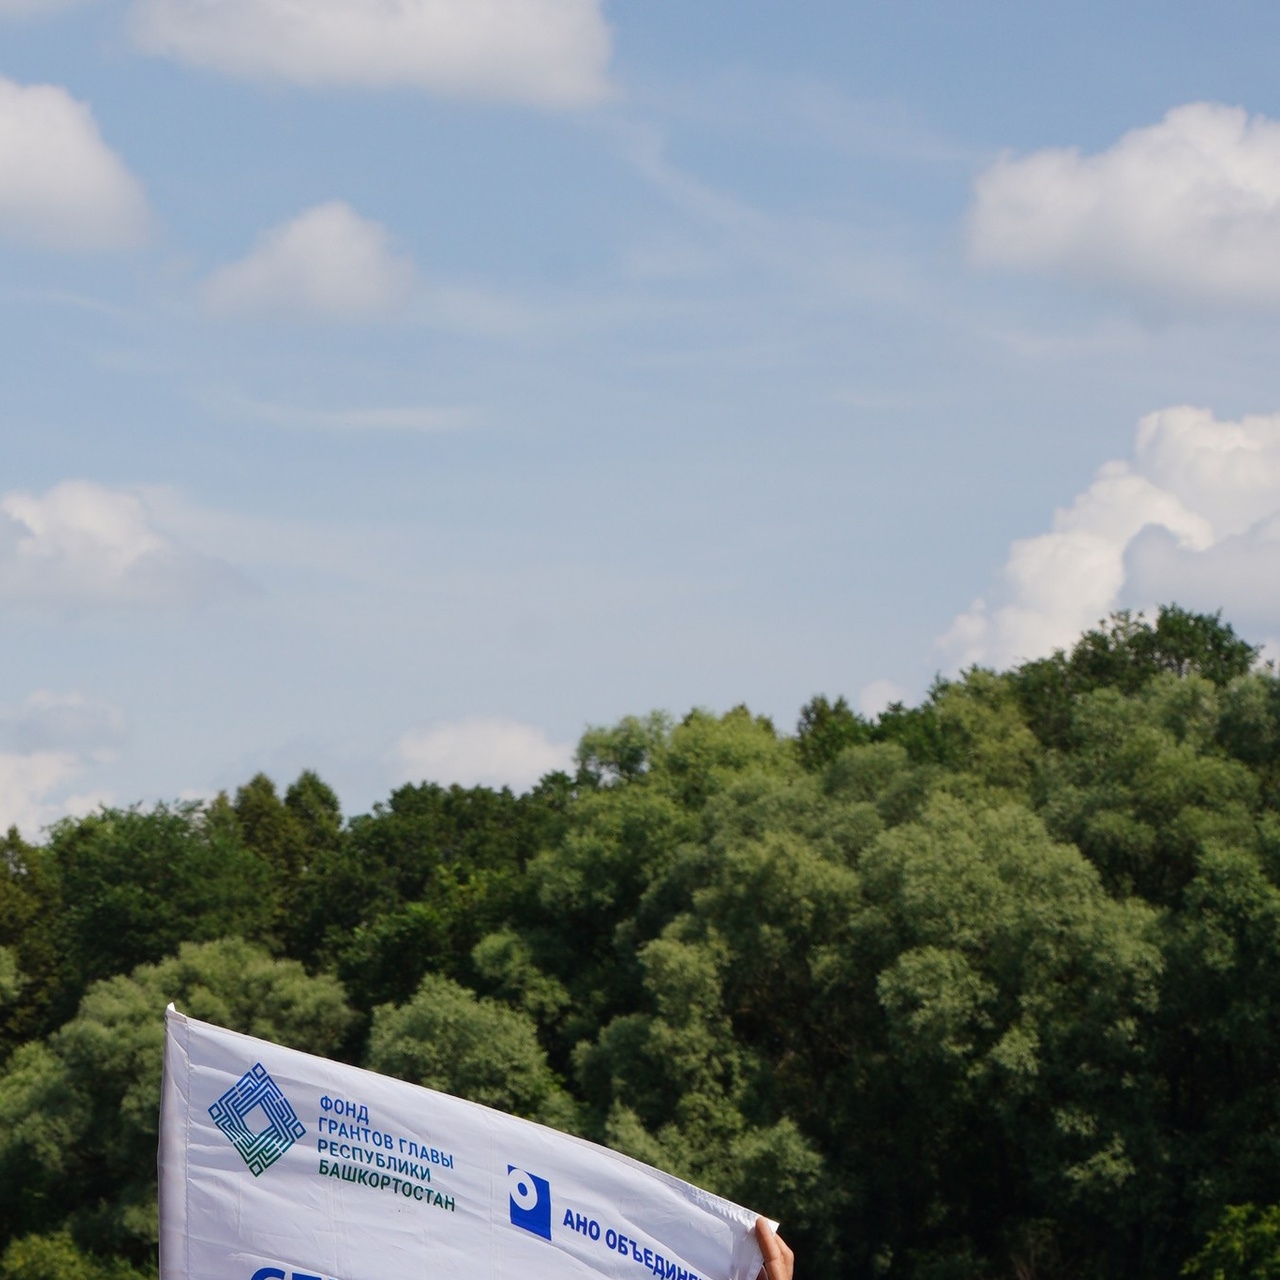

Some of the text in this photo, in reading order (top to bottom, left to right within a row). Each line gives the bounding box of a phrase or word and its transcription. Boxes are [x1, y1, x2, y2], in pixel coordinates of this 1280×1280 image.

[320, 1095, 369, 1125] ФОНД
[317, 1138, 431, 1183] РЕСПУБЛИКИ
[318, 1116, 454, 1169] ГРАНТОВ ГЛАВЫ
[318, 1158, 456, 1212] БАШКОРТОСТАН
[562, 1208, 600, 1242] АНО
